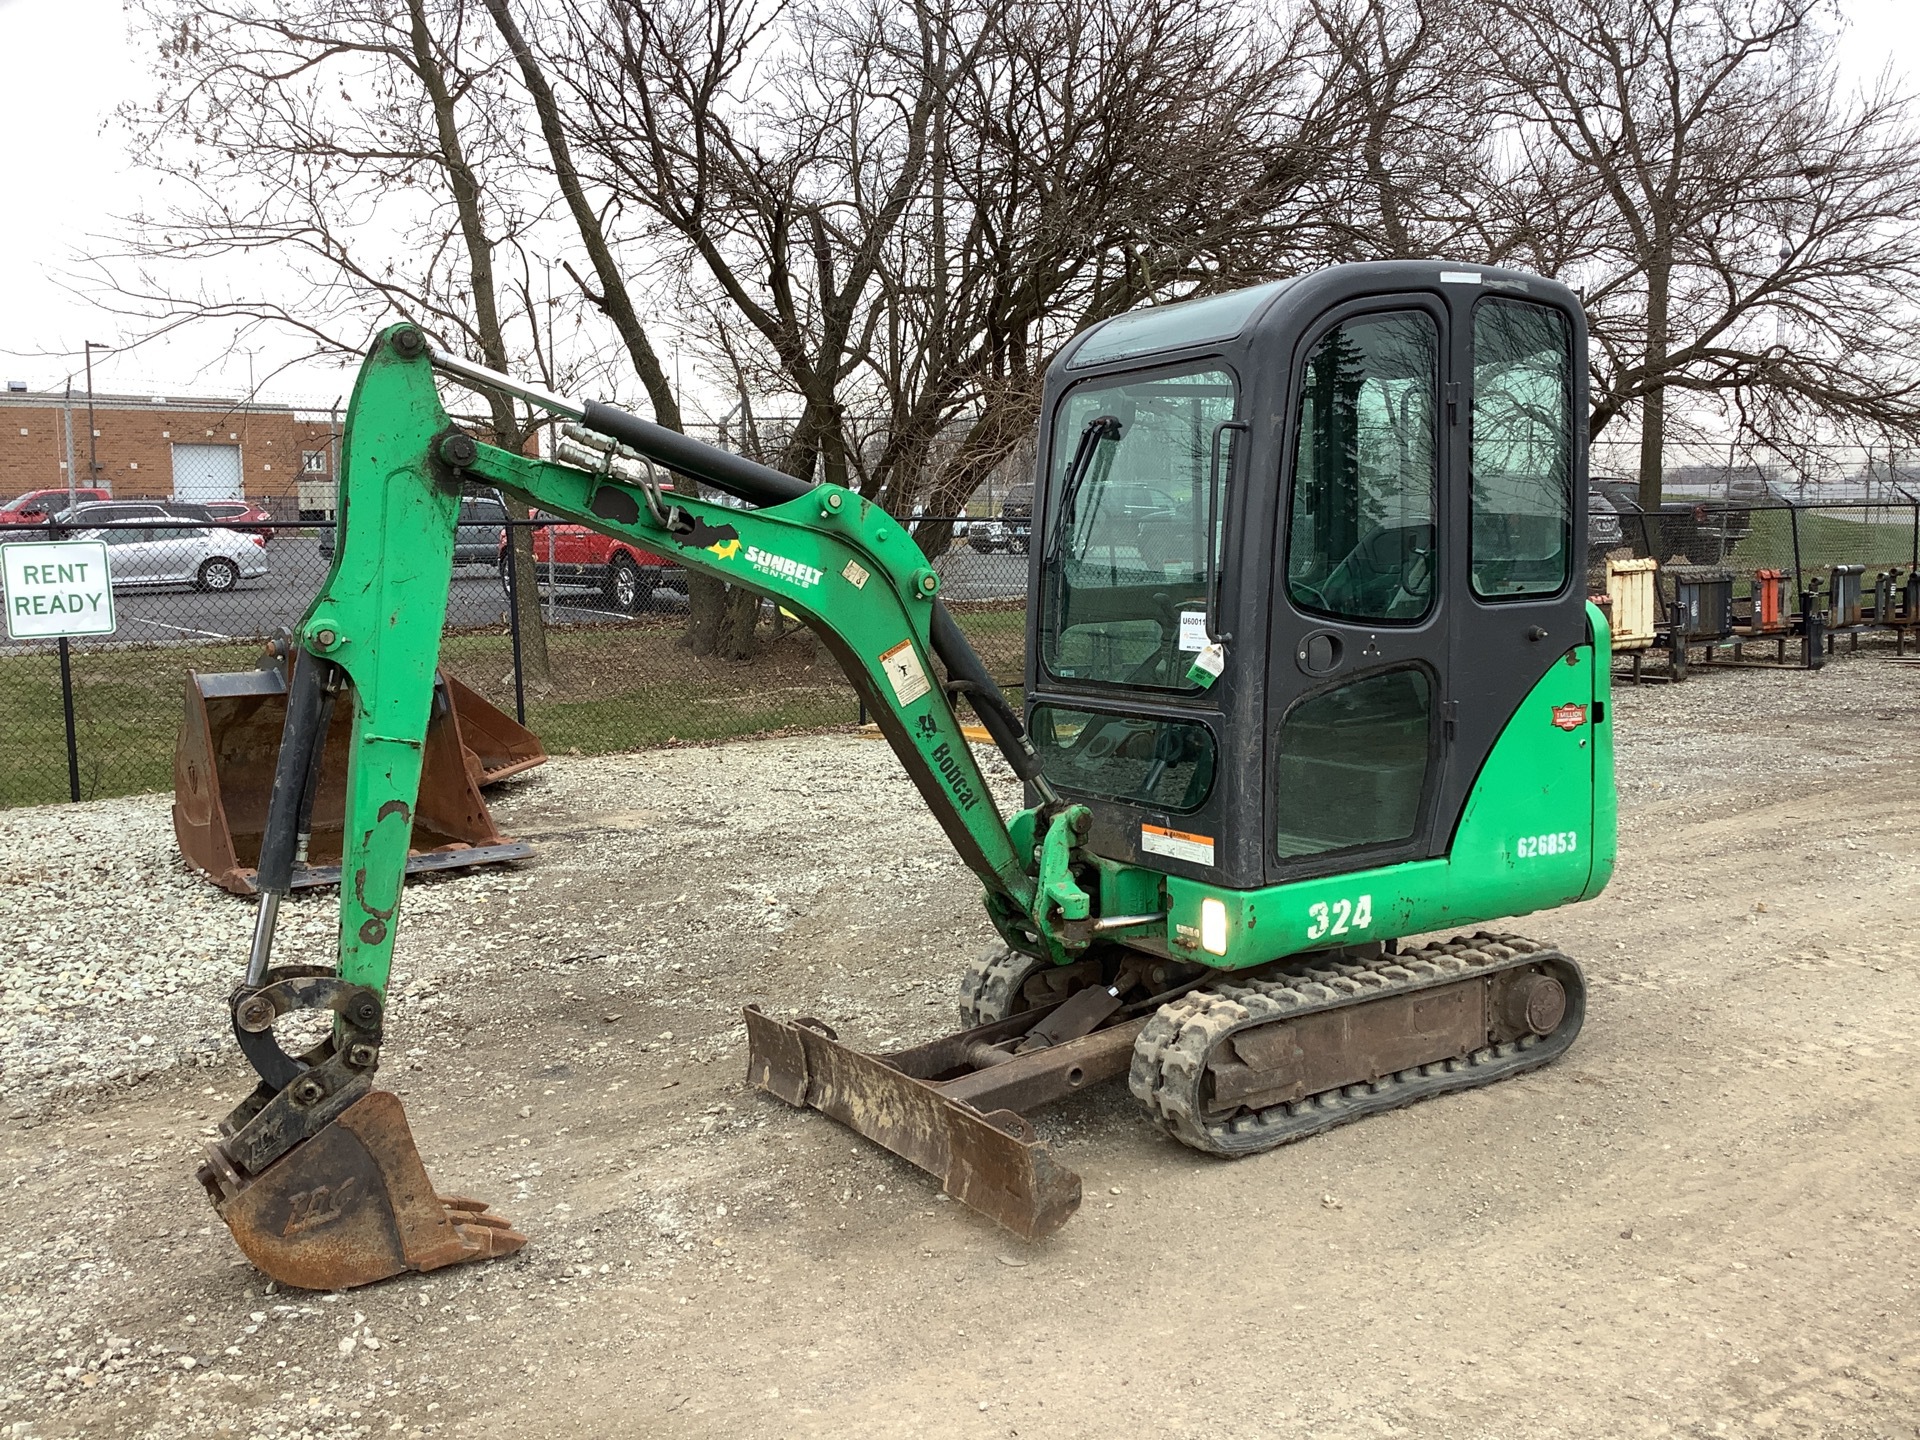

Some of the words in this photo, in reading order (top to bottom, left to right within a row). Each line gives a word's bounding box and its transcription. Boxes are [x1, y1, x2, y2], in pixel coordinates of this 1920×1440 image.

[23, 563, 89, 585] RENT
[744, 546, 824, 586] SUNBELT
[753, 563, 810, 589] RENTALS
[14, 592, 103, 616] READY
[1754, 600, 1762, 613] 5K
[931, 742, 981, 812] Bobcat
[1517, 831, 1577, 859] 626853
[1307, 894, 1373, 940] 324
